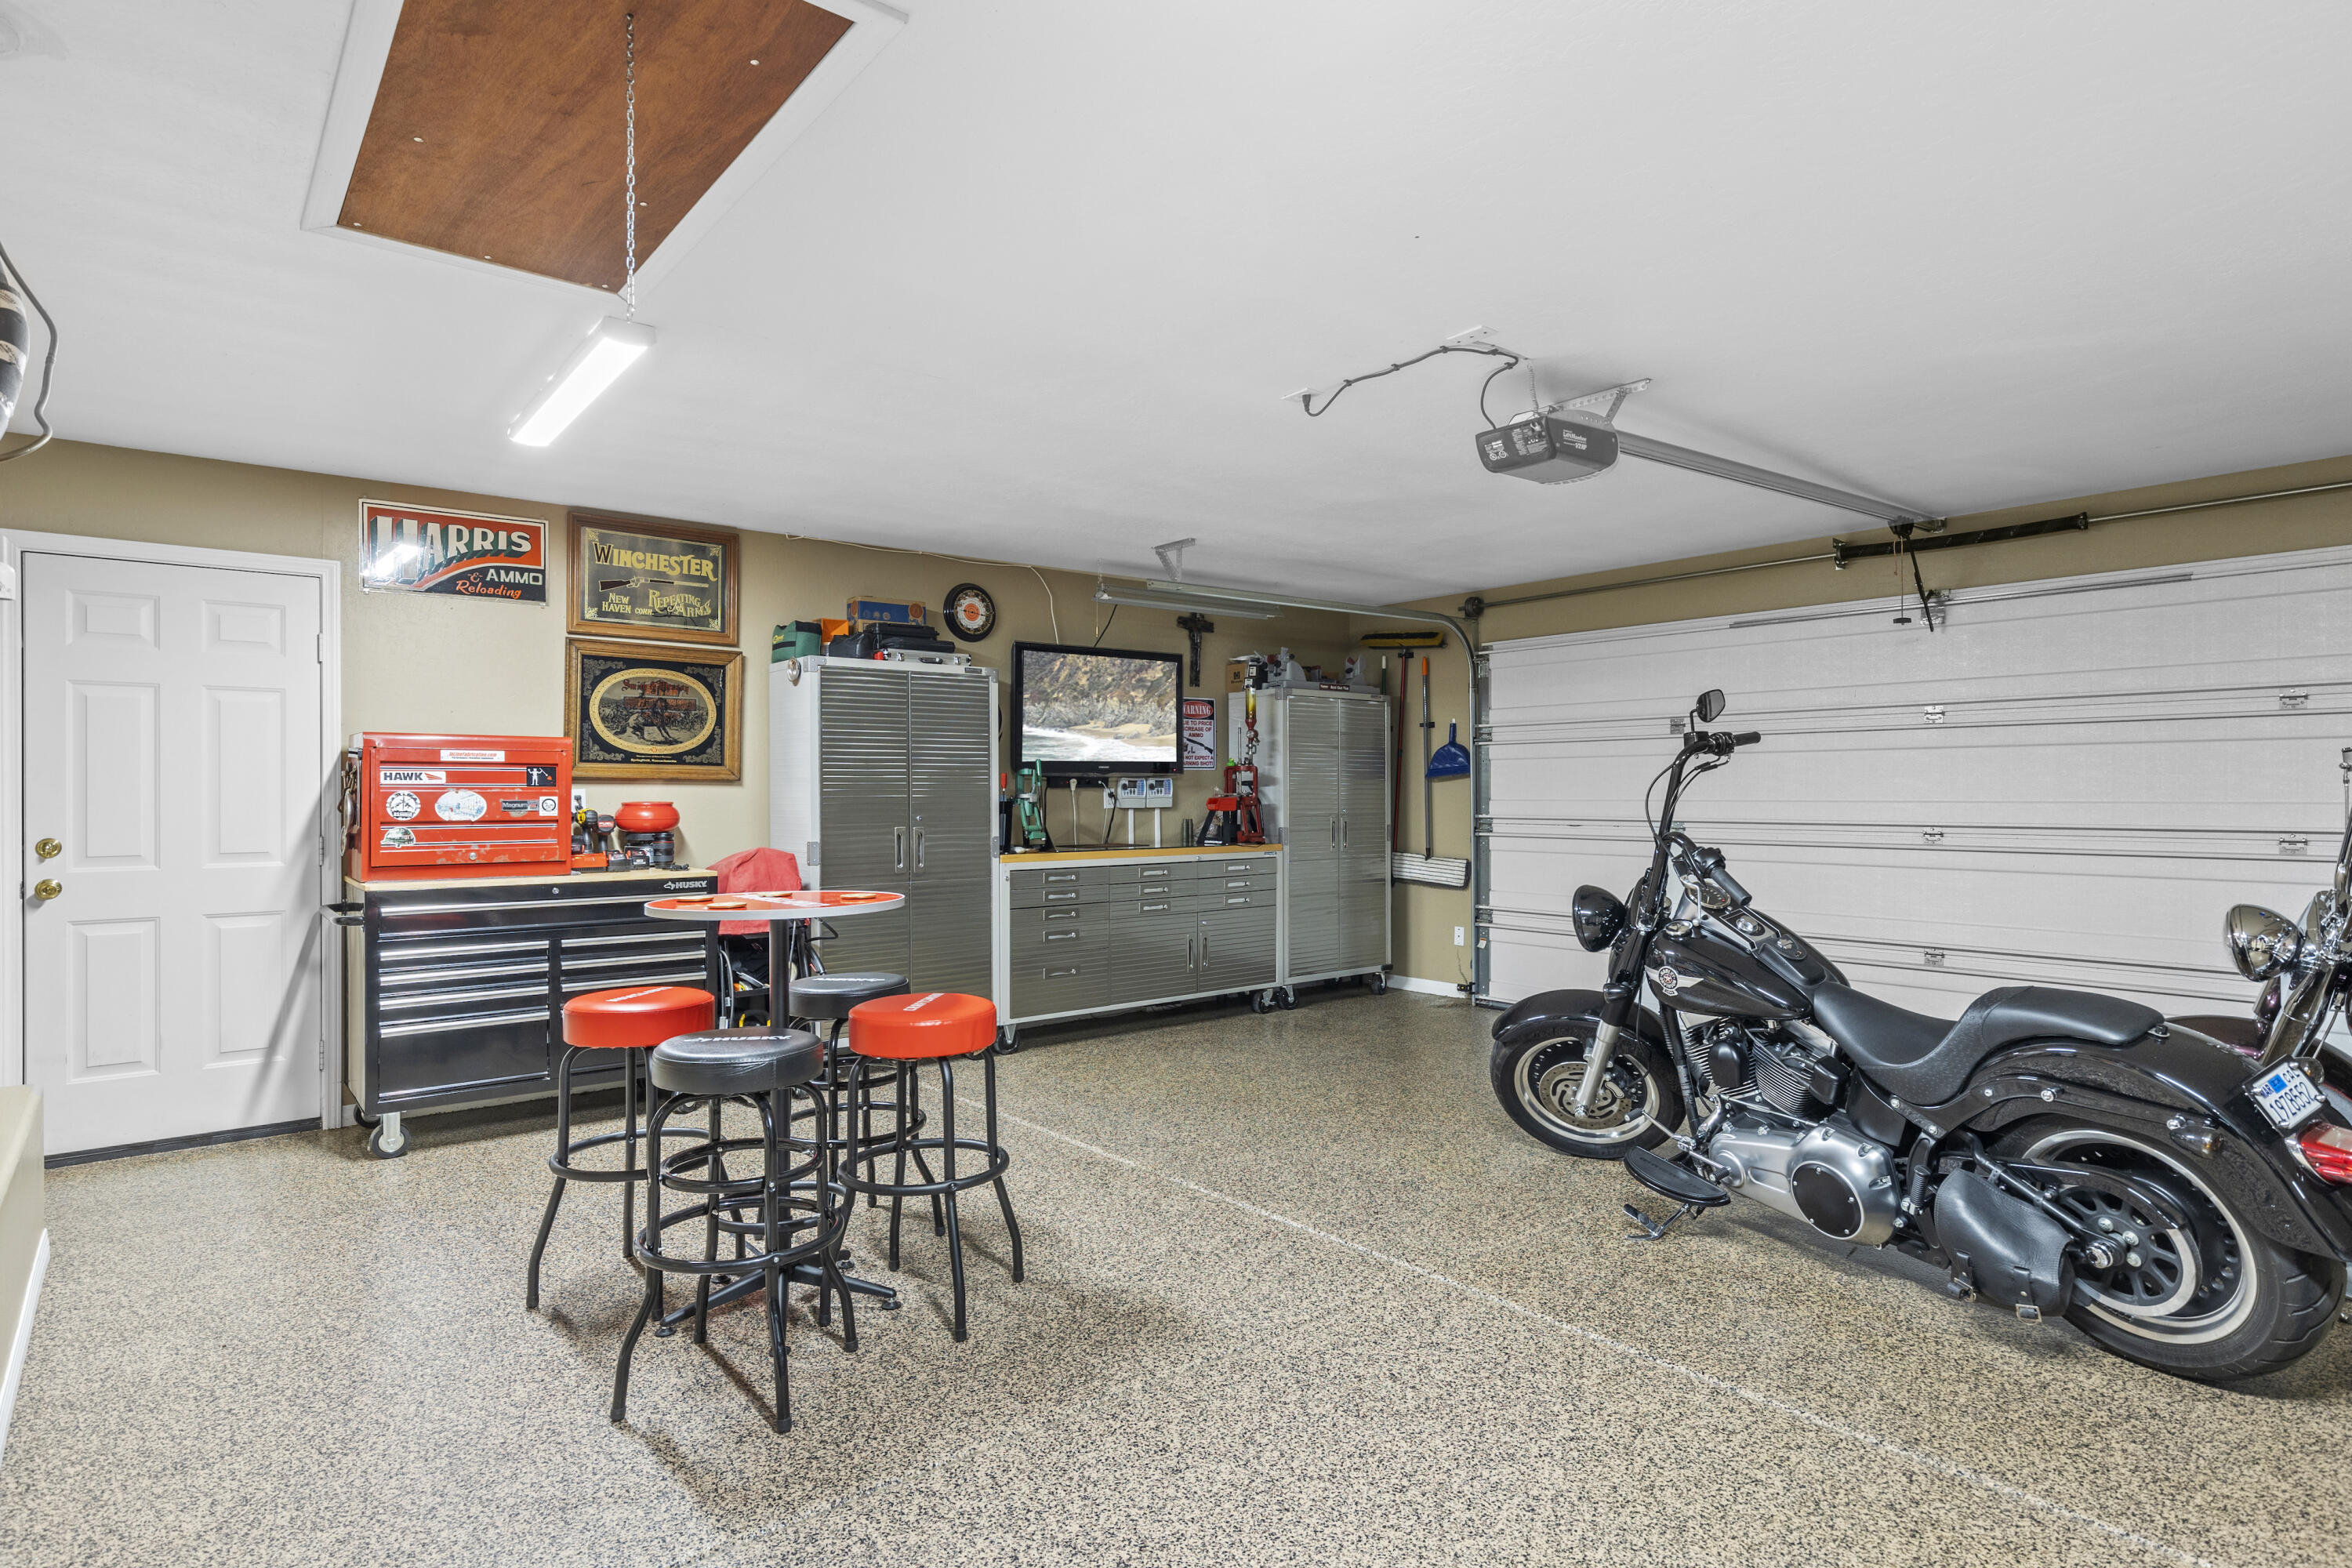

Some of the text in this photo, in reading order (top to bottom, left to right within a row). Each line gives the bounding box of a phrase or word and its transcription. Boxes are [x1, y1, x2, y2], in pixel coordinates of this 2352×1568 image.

[370, 515, 532, 580] HARRIS
[592, 542, 718, 582] WINCHESTER
[485, 568, 543, 586] AMMO
[456, 579, 522, 600] Reloading
[608, 592, 631, 604] NEW
[602, 601, 632, 614] HAVEN
[648, 589, 702, 614] REPEATING
[674, 599, 712, 617] ARMS
[383, 772, 423, 781] HAWK
[675, 880, 708, 889] HUSKY
